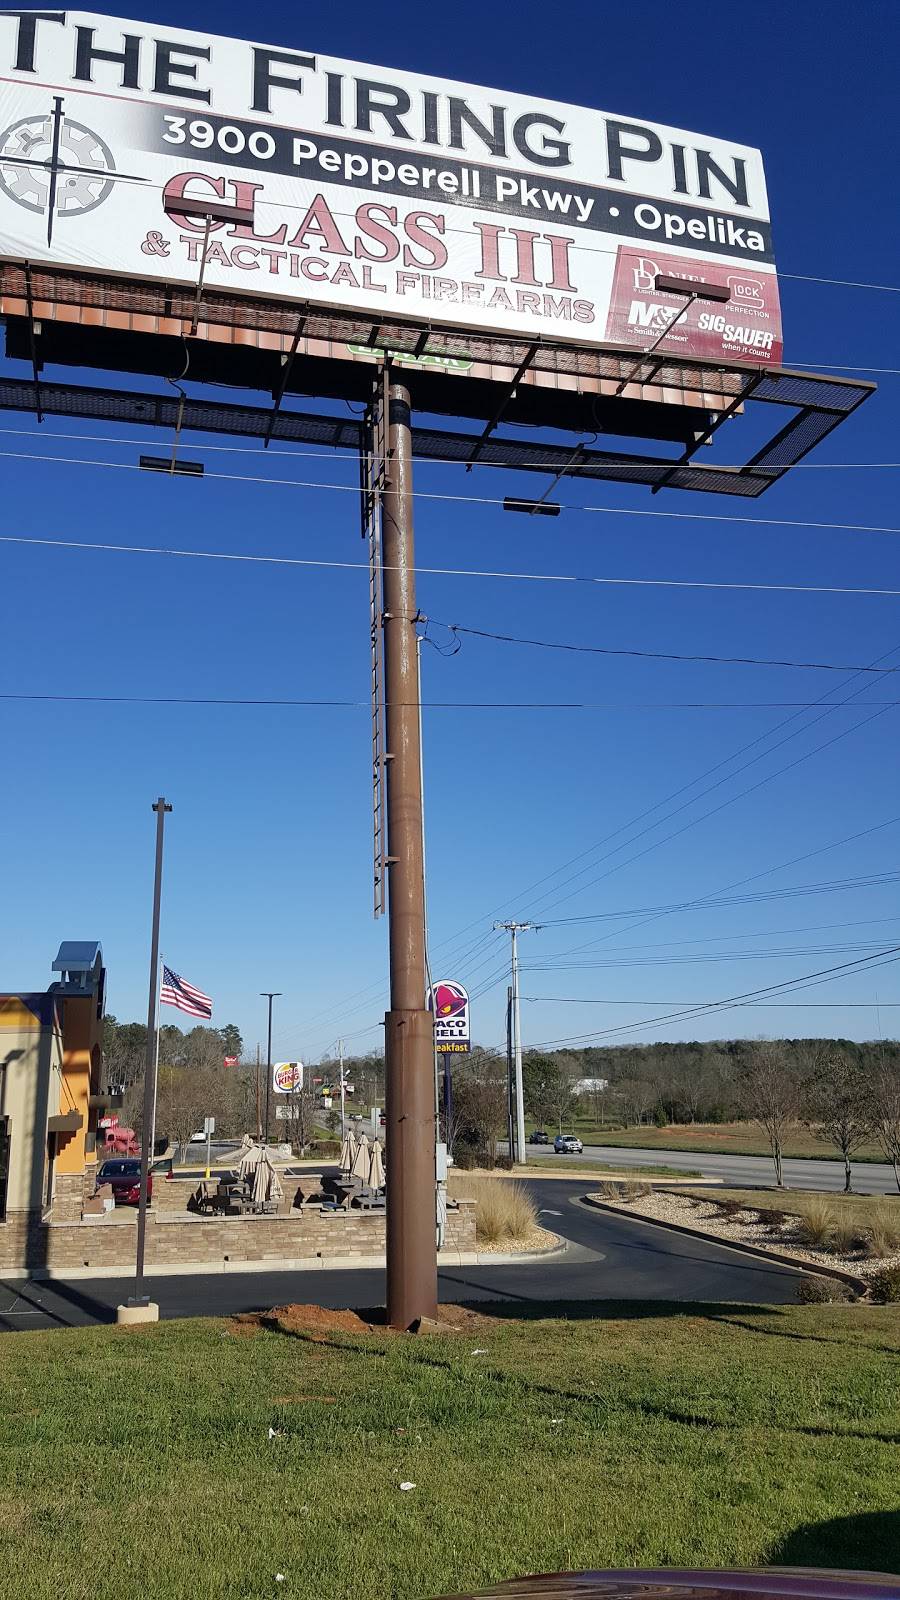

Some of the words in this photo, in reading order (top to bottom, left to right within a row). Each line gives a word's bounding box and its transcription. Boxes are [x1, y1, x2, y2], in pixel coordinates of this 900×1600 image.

[0, 11, 212, 106] THE
[250, 46, 573, 168] FIRING
[603, 118, 752, 207] PIN
[162, 115, 276, 160] 3900
[292, 138, 480, 198] Pepperell
[496, 174, 595, 222] Pkwy
[633, 203, 765, 252] Opelika
[162, 172, 448, 270] CLASS
[473, 221, 578, 293] III
[141, 231, 170, 257] &
[180, 235, 387, 293] TACTICAL
[396, 270, 596, 324] FIREARMS
[725, 305, 770, 319] PERFECTION
[664, 331, 688, 342] esson
[721, 342, 741, 352] when
[748, 347, 771, 359] counts
[433, 1020, 466, 1028] ACO
[433, 1043, 468, 1052] eakfast
[277, 1068, 299, 1079] BURGR
